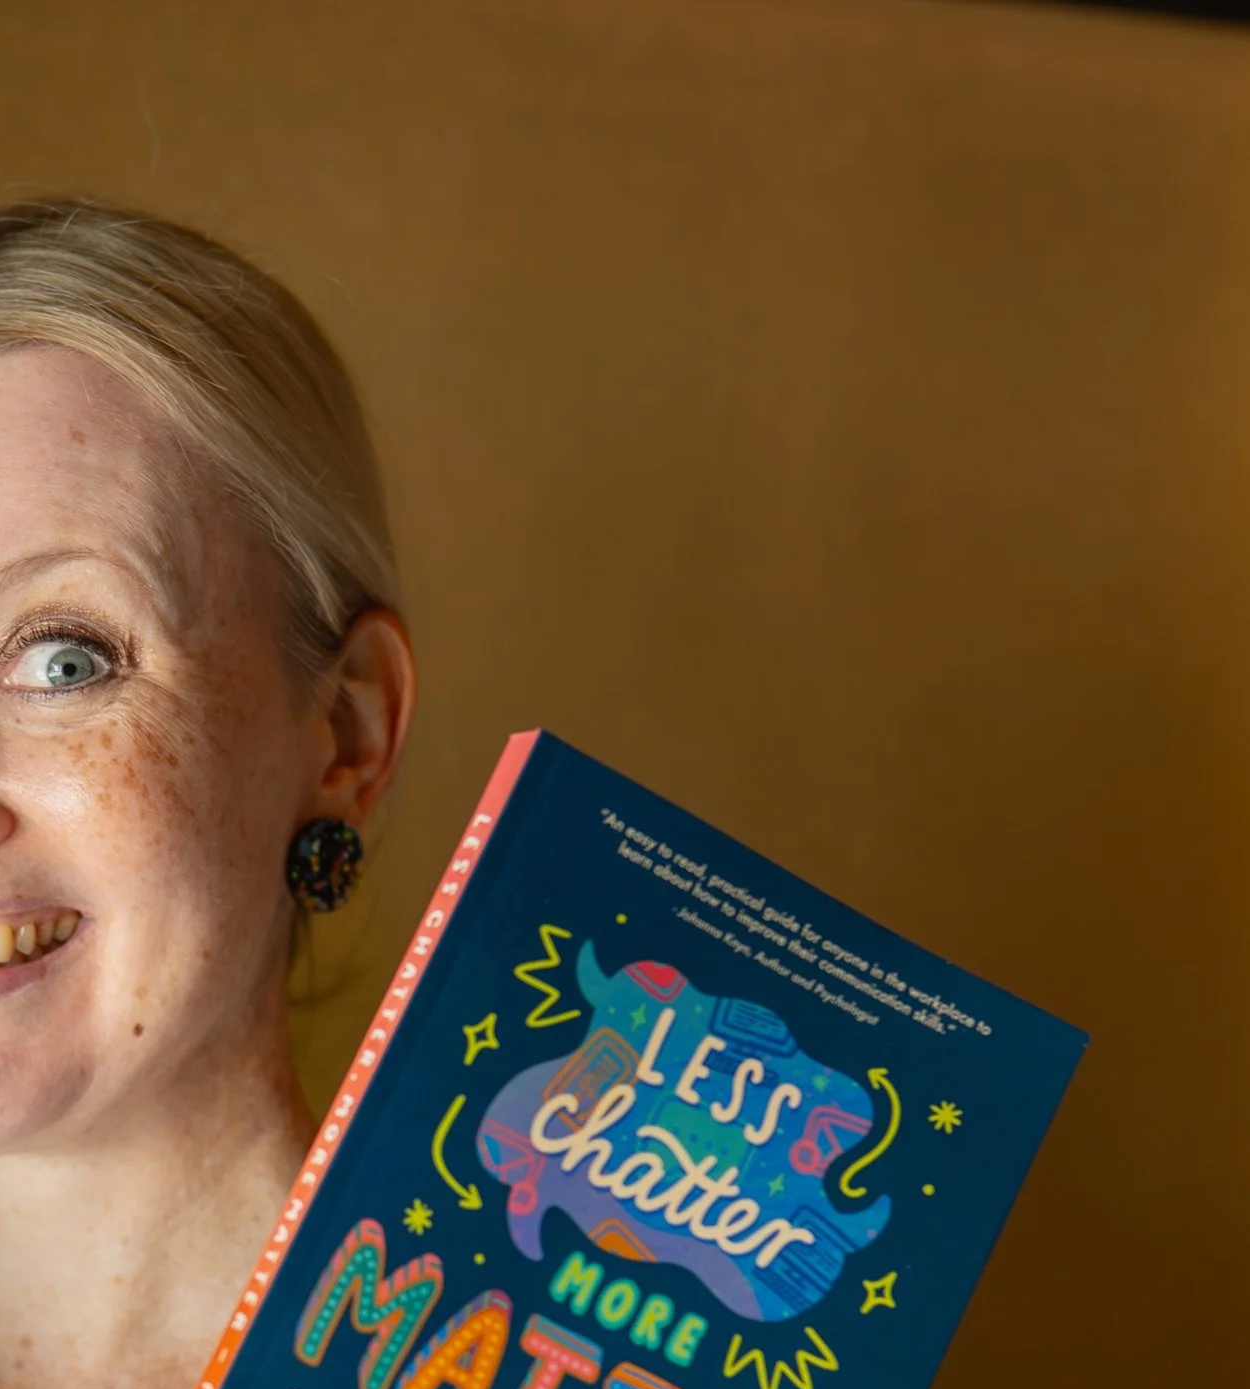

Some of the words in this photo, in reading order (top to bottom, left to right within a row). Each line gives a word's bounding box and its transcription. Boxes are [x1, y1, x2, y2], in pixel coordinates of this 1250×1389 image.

[441, 813, 492, 895] LESS
[601, 808, 625, 832] "An
[625, 827, 658, 852] easy
[657, 843, 673, 859] to
[672, 853, 708, 881] read,
[706, 875, 766, 911] practical
[762, 906, 801, 933] guide
[800, 923, 823, 944] for
[821, 940, 870, 972] anyone
[884, 972, 907, 992] the
[909, 987, 976, 1028] workplace
[976, 1020, 992, 1036] to
[617, 840, 653, 870] learn
[653, 864, 693, 891] about
[691, 882, 722, 907] how
[720, 901, 736, 917] to
[736, 909, 788, 947] improve
[787, 939, 819, 963] their
[818, 959, 912, 1016] communication
[912, 1009, 957, 1035] skills."
[753, 951, 792, 977] Author
[302, 1094, 354, 1184] MORE
[636, 1008, 802, 1144] LESS
[529, 1083, 814, 1268] chatter
[232, 1198, 304, 1330] MATTER
[549, 1251, 709, 1368] MORE
